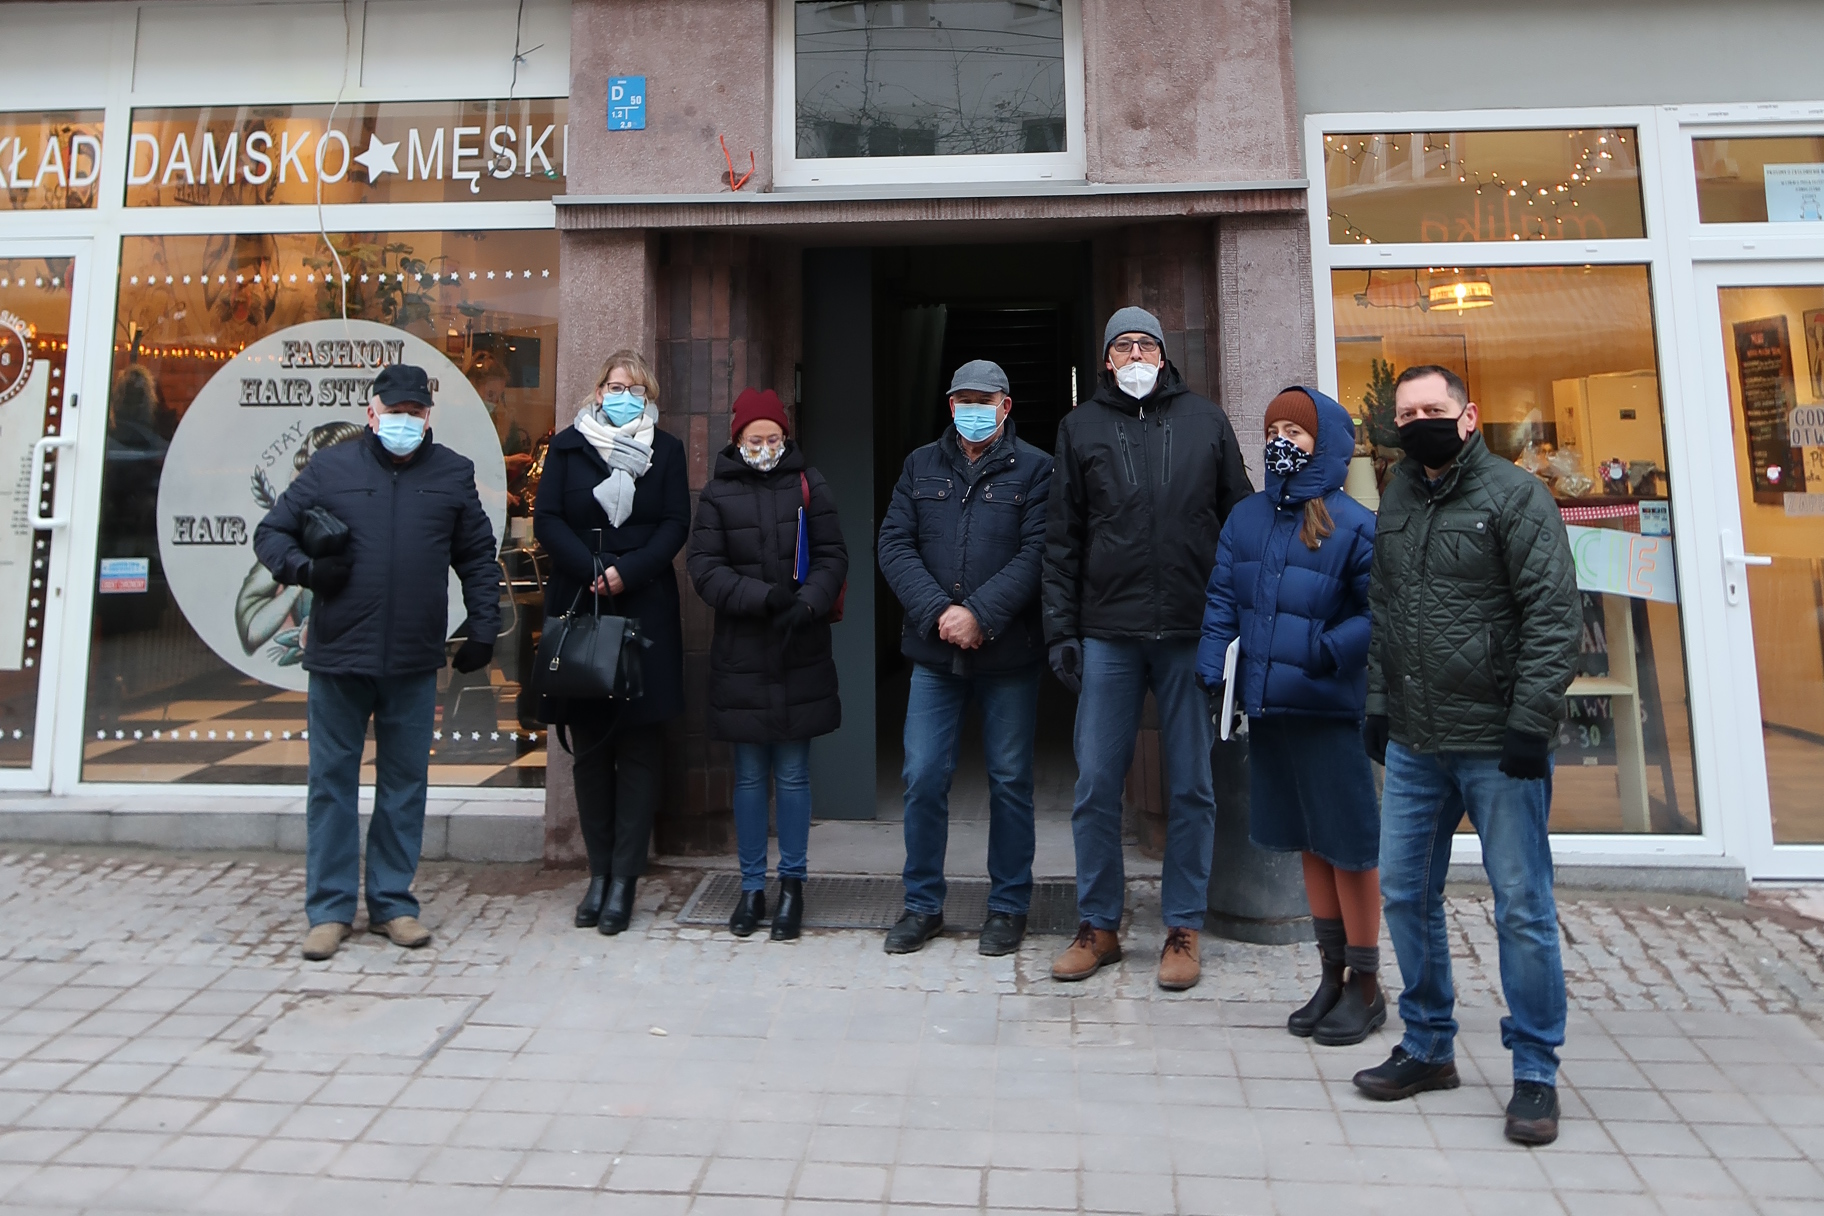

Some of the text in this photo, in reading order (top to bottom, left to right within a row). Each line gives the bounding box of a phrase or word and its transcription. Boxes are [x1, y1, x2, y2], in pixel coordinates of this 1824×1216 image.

[611, 86, 624, 101] D
[630, 95, 642, 105] 50
[127, 130, 351, 185] DAMSKO
[281, 339, 405, 369] FASHION
[239, 377, 440, 407] HAIR STYT
[261, 419, 304, 468] STAY
[171, 515, 248, 546] HAIR
